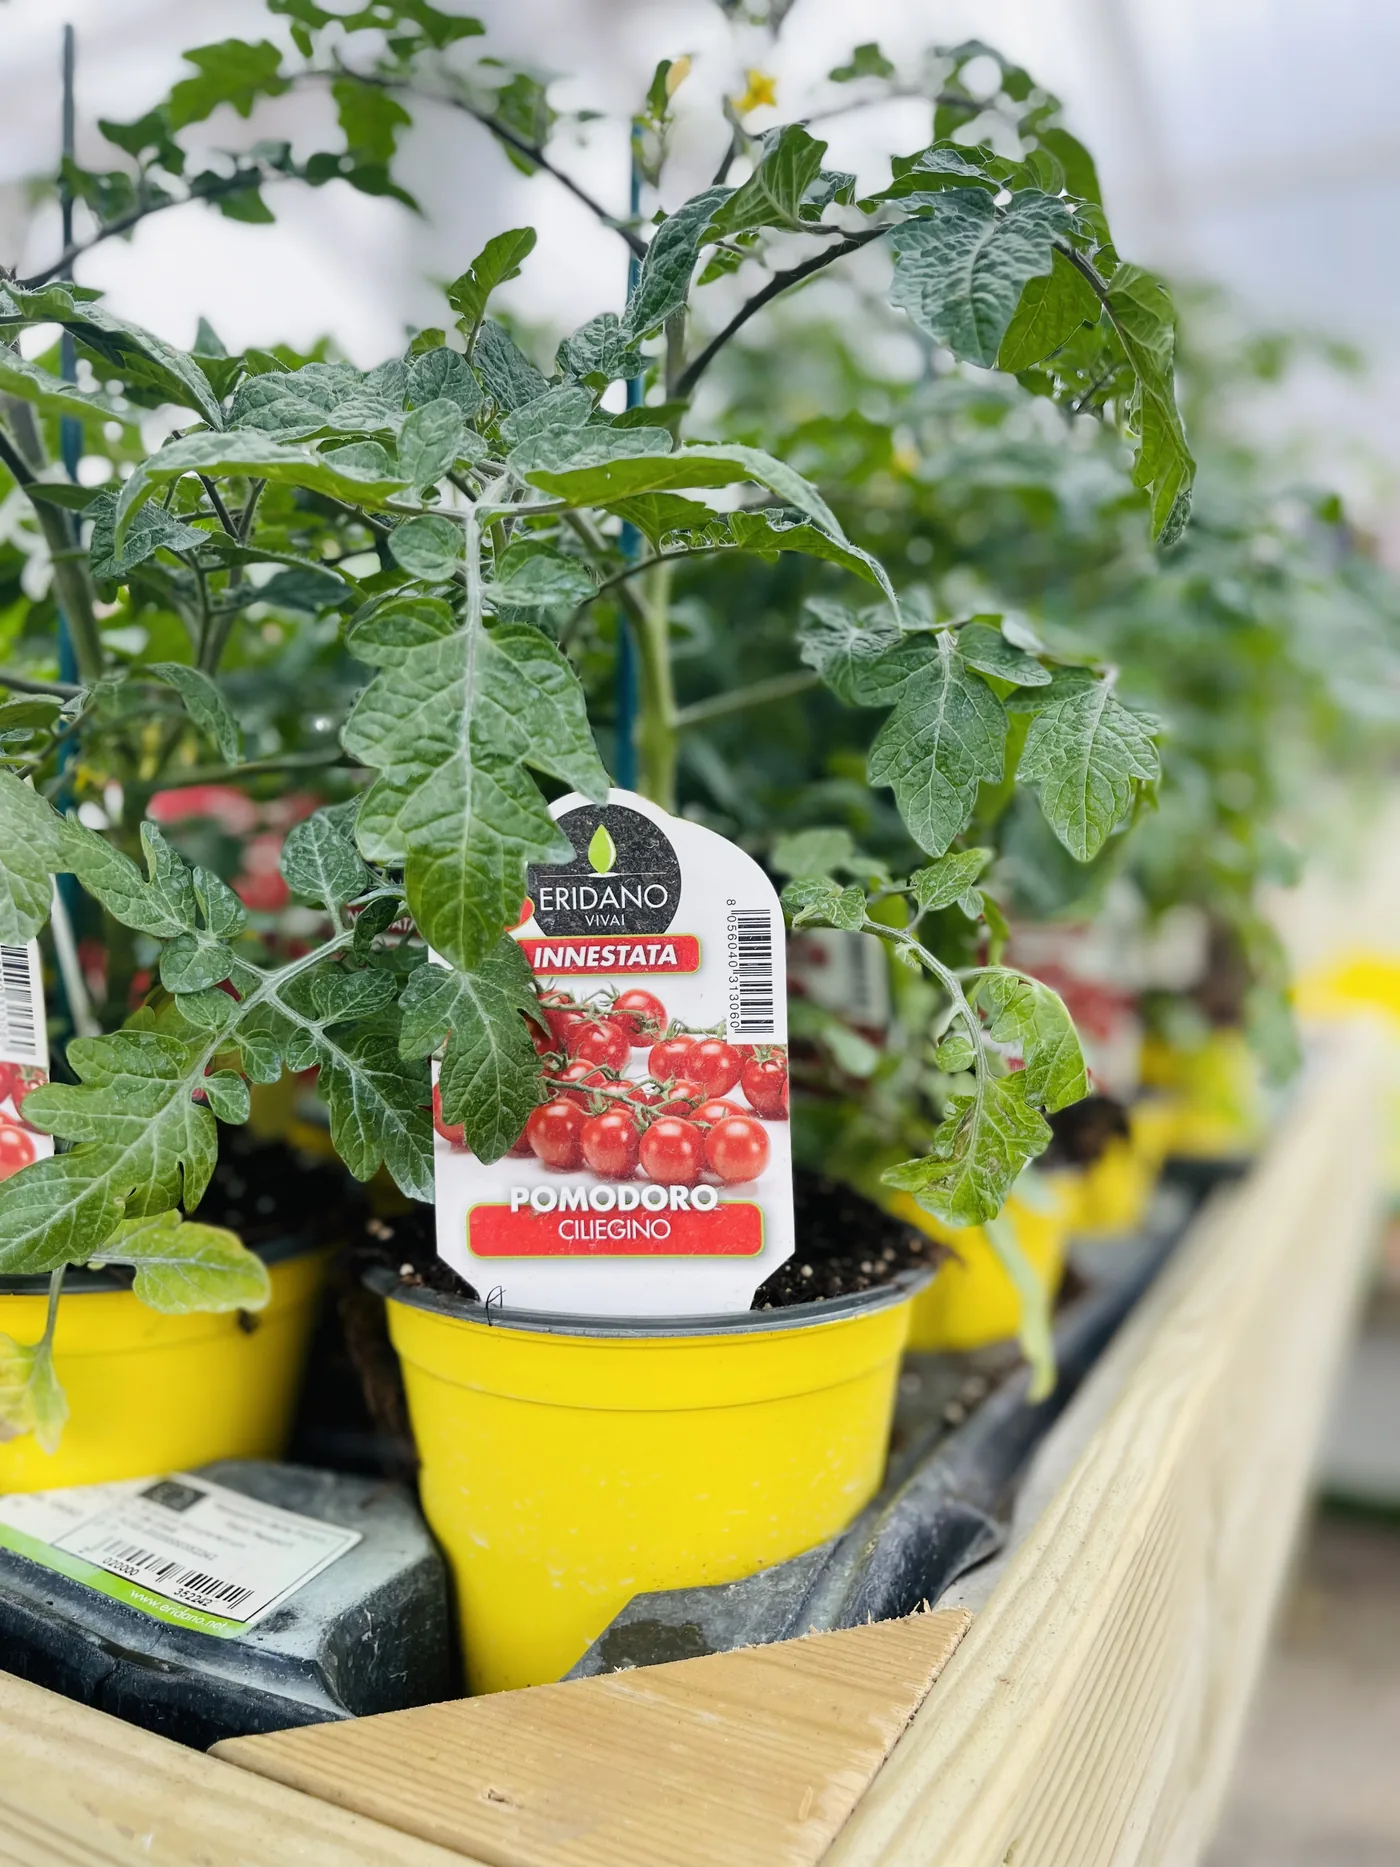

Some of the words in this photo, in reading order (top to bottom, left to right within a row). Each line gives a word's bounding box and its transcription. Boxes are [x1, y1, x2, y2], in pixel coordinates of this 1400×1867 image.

[539, 883, 668, 911] ERIDANO
[584, 913, 626, 927] VIVAI
[533, 943, 678, 969] INNESTATA
[510, 1183, 719, 1213] POMODORO
[557, 1218, 672, 1241] CILIEGINO
[129, 1588, 228, 1631] www.eridano.net
